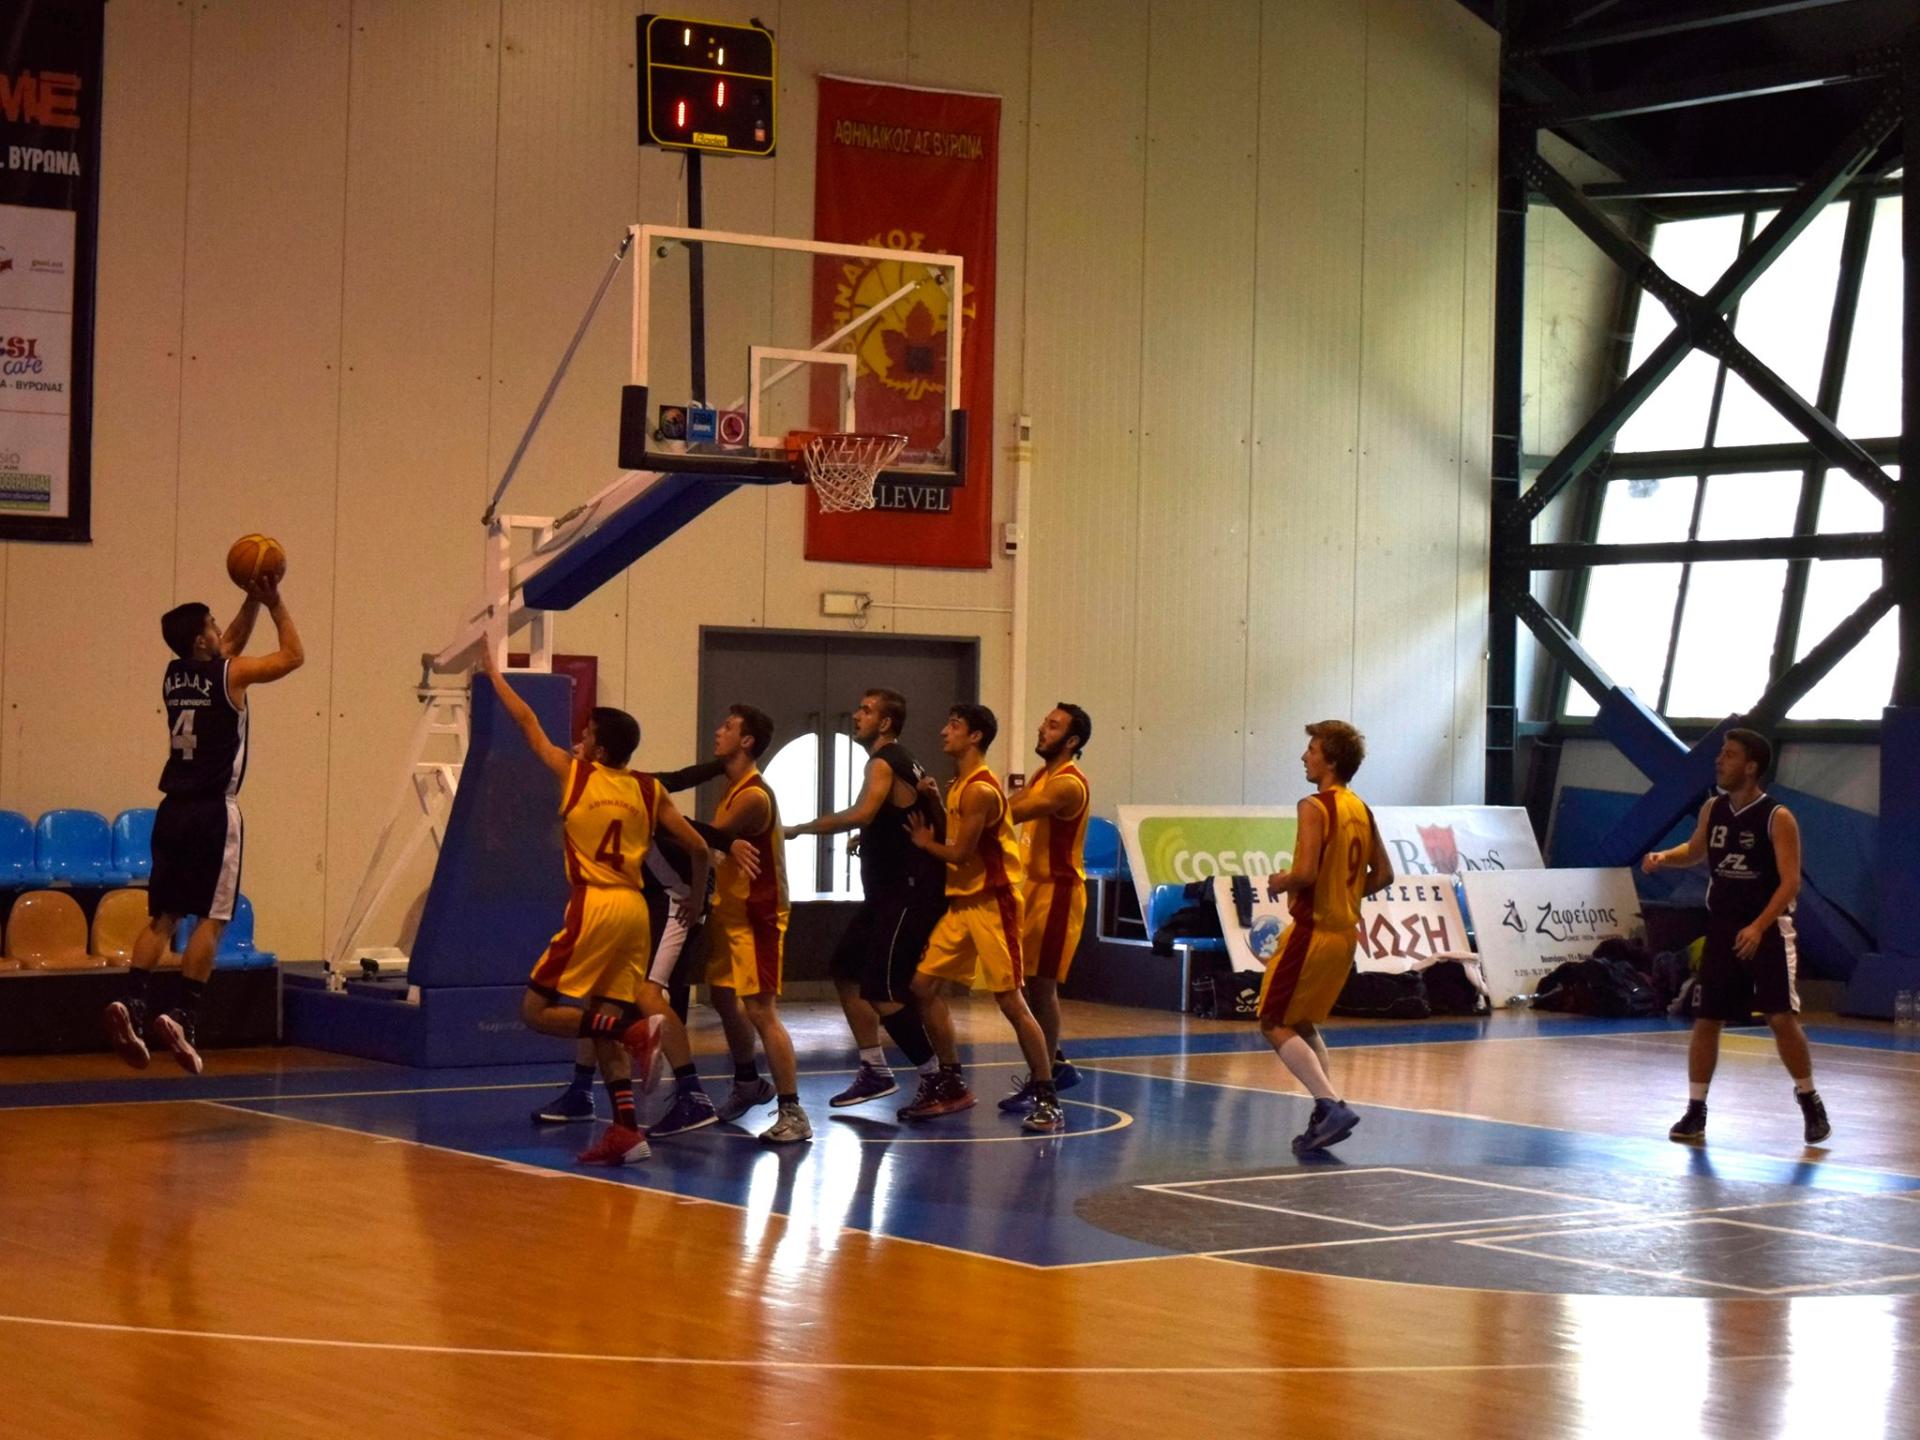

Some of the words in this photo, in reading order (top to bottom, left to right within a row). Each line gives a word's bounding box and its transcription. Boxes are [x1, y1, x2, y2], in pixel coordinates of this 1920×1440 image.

[9, 145, 80, 176] ΒΥΡΩΝΑ
[171, 709, 197, 760] 4
[595, 819, 625, 872] 4
